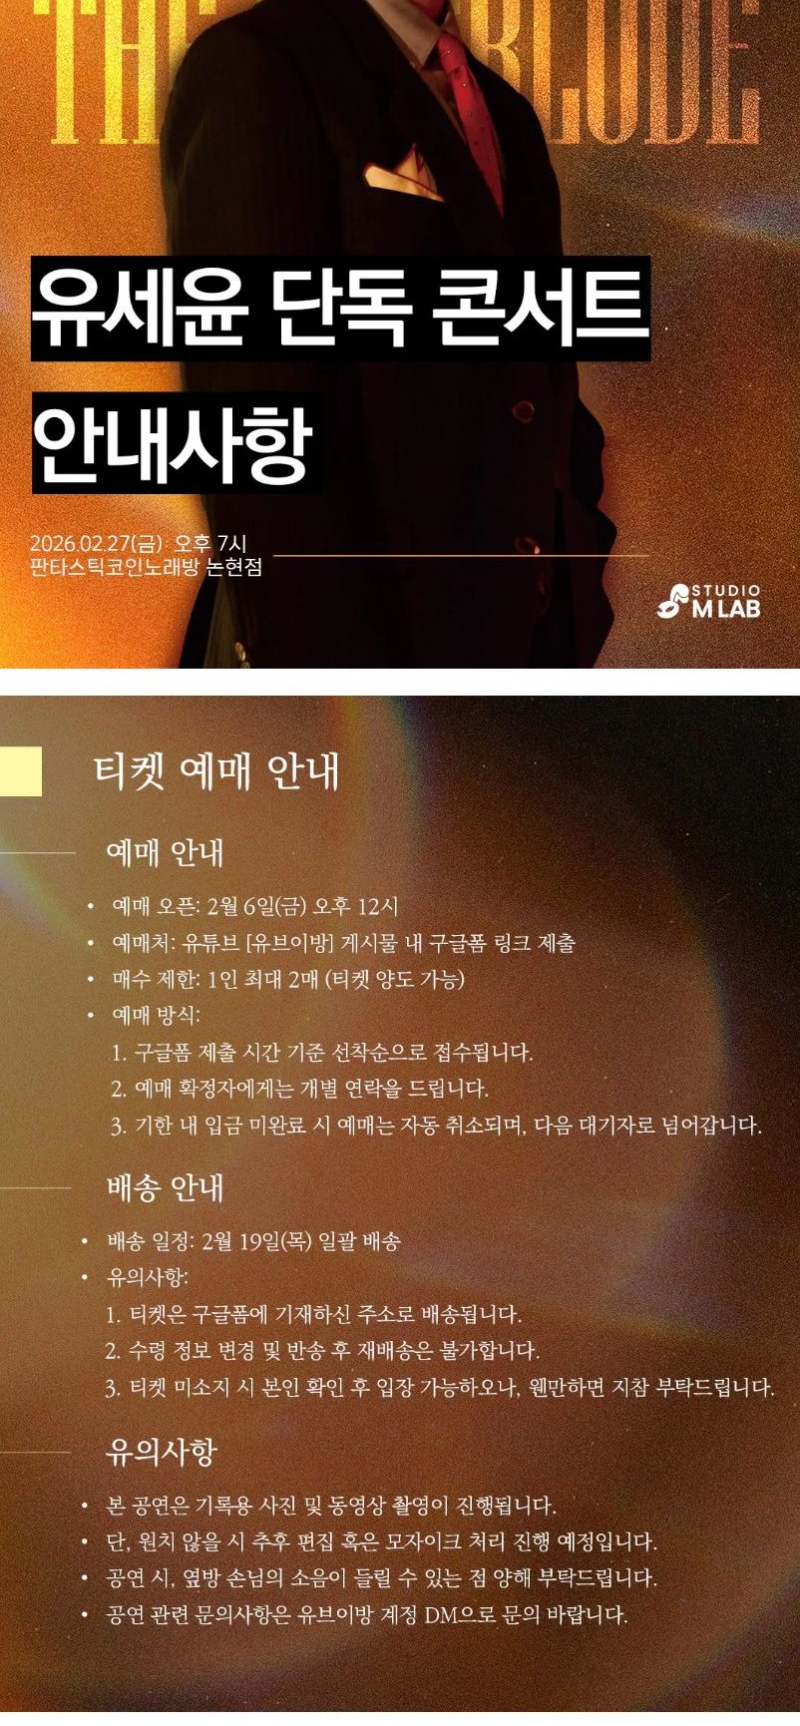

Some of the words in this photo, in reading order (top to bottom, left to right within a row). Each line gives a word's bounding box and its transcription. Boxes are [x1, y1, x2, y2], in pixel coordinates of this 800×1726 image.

[31, 267, 250, 348] 유세윤
[272, 267, 414, 348] 단독
[432, 267, 650, 347] 콘서트
[33, 406, 313, 486] 안내사항
[30, 534, 163, 554] 2026.02.27(금)
[174, 533, 212, 554] 오후
[217, 534, 246, 554] 7시
[30, 557, 201, 577] 판타스틱코인노래방
[206, 556, 262, 577] 논현점
[691, 584, 761, 597] STUDIO
[692, 599, 713, 618] M
[718, 599, 761, 618] LAB
[93, 751, 164, 792] 티켓
[180, 751, 250, 791] 예매
[267, 751, 338, 792] 안내
[106, 837, 159, 868] 예매
[171, 837, 223, 868] 안내
[112, 896, 150, 917] 예매
[156, 896, 200, 917] 오픈:
[207, 896, 238, 917] 2월
[243, 895, 307, 918] 6일(금)
[312, 896, 351, 917] 오후
[358, 895, 398, 918] 12시
[106, 1172, 162, 1203] 배송
[171, 1173, 223, 1203] 안내
[107, 1230, 146, 1252] 배송
[152, 1230, 194, 1252] 일정:
[202, 1230, 232, 1252] 2월
[240, 1230, 312, 1253] 19일(목)
[318, 1230, 358, 1252] 일괄
[362, 1230, 402, 1252] 배송
[105, 1437, 218, 1468] 유의사항
[105, 1604, 145, 1626] 공연
[150, 1604, 189, 1626] 관련
[194, 1604, 292, 1626] 문의사항은
[297, 1604, 375, 1626] 유브이방
[381, 1604, 417, 1626] 계정
[424, 1606, 497, 1624] DM으로
[501, 1604, 540, 1626] 문의
[547, 1604, 628, 1626] 바랍니다.
